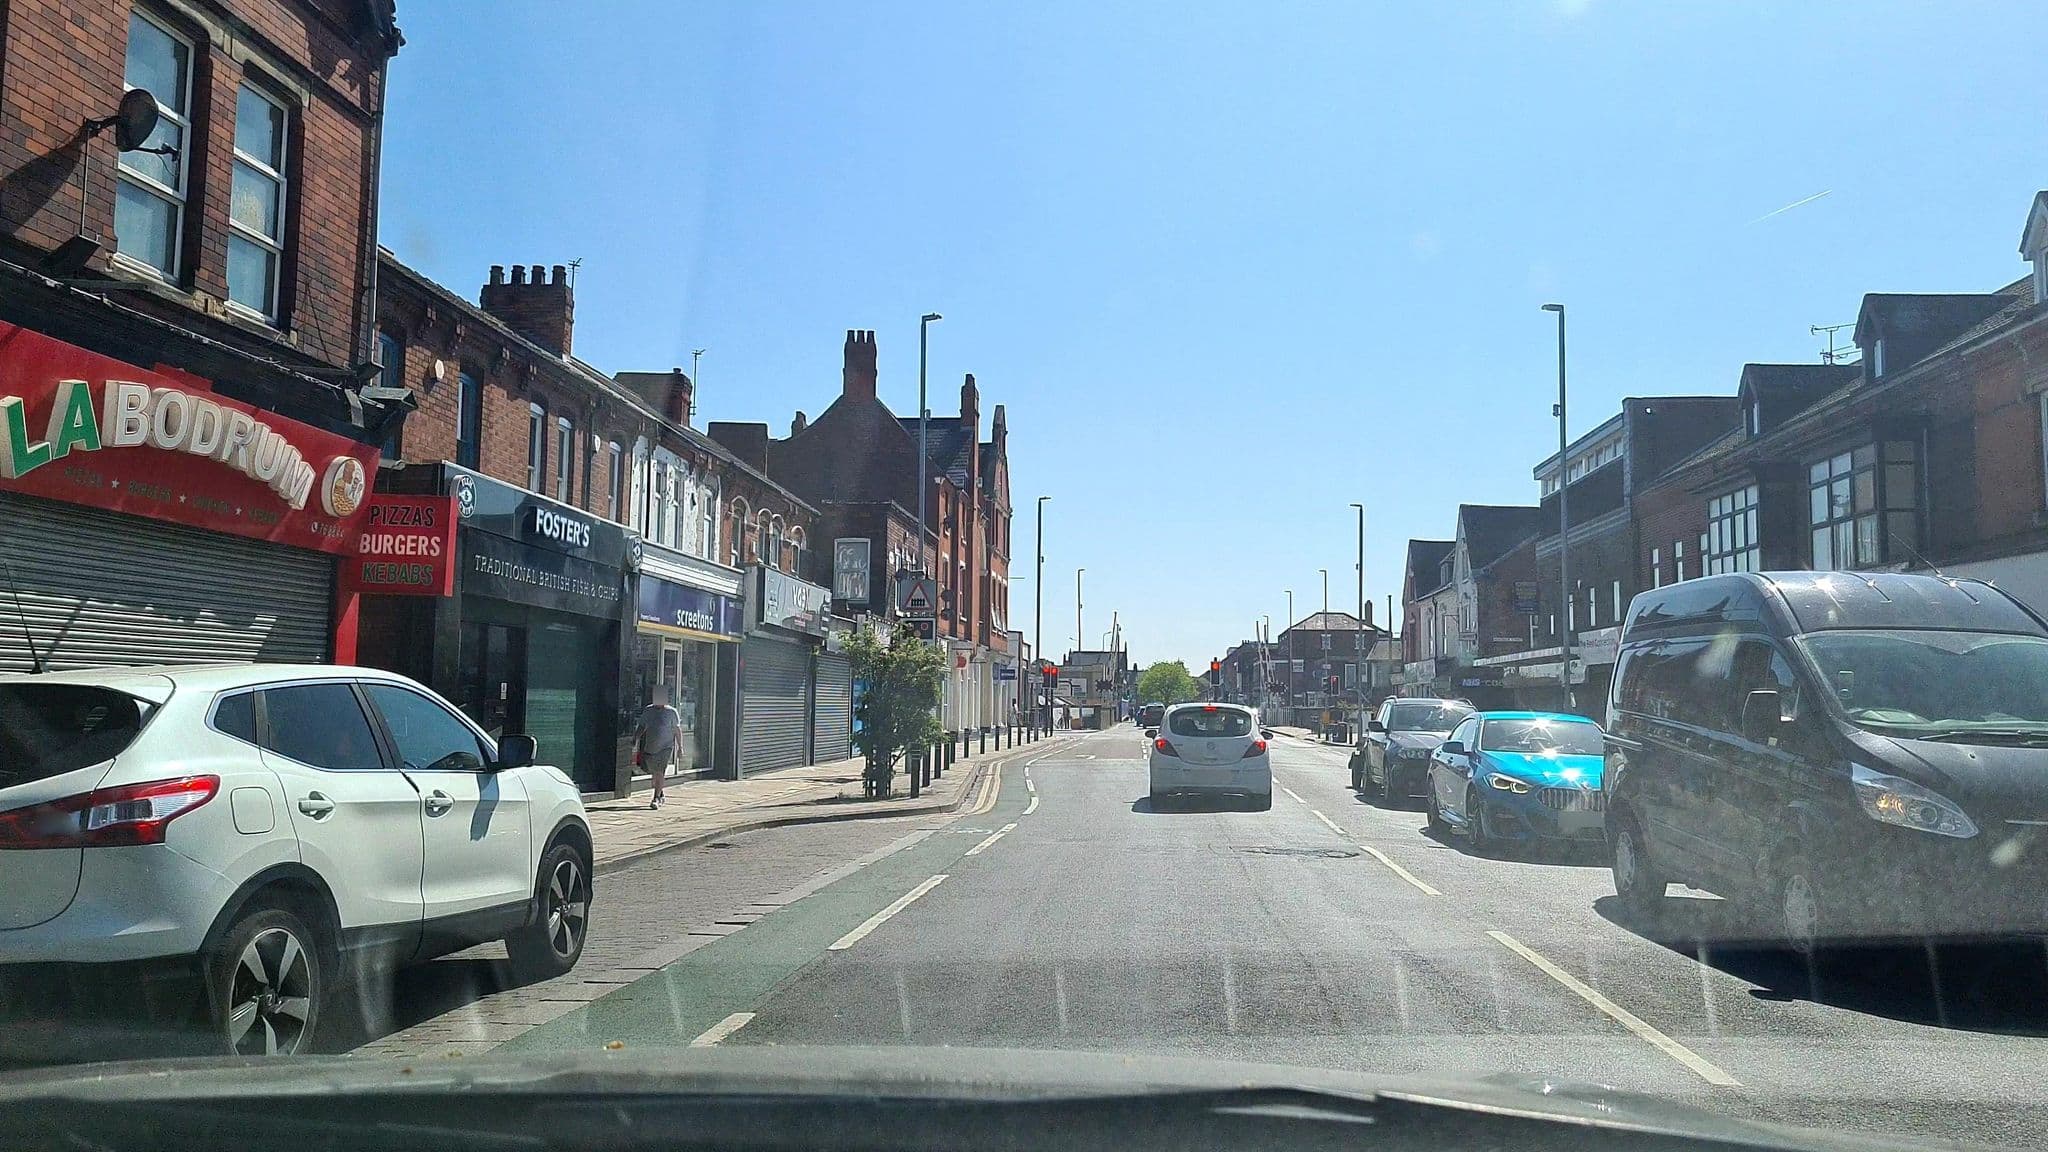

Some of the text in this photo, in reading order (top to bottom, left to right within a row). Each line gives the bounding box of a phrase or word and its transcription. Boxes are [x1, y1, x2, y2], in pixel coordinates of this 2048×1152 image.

[1, 380, 314, 510] LA BODRUM
[368, 504, 435, 528] PIZZAS
[536, 508, 590, 548] FOSTER'S
[359, 533, 441, 557] BURGERS
[361, 562, 433, 585] KEBABS
[475, 554, 619, 601] TRADITIONAL BRITISH FISH & CHIPS
[676, 608, 713, 632] screetons
